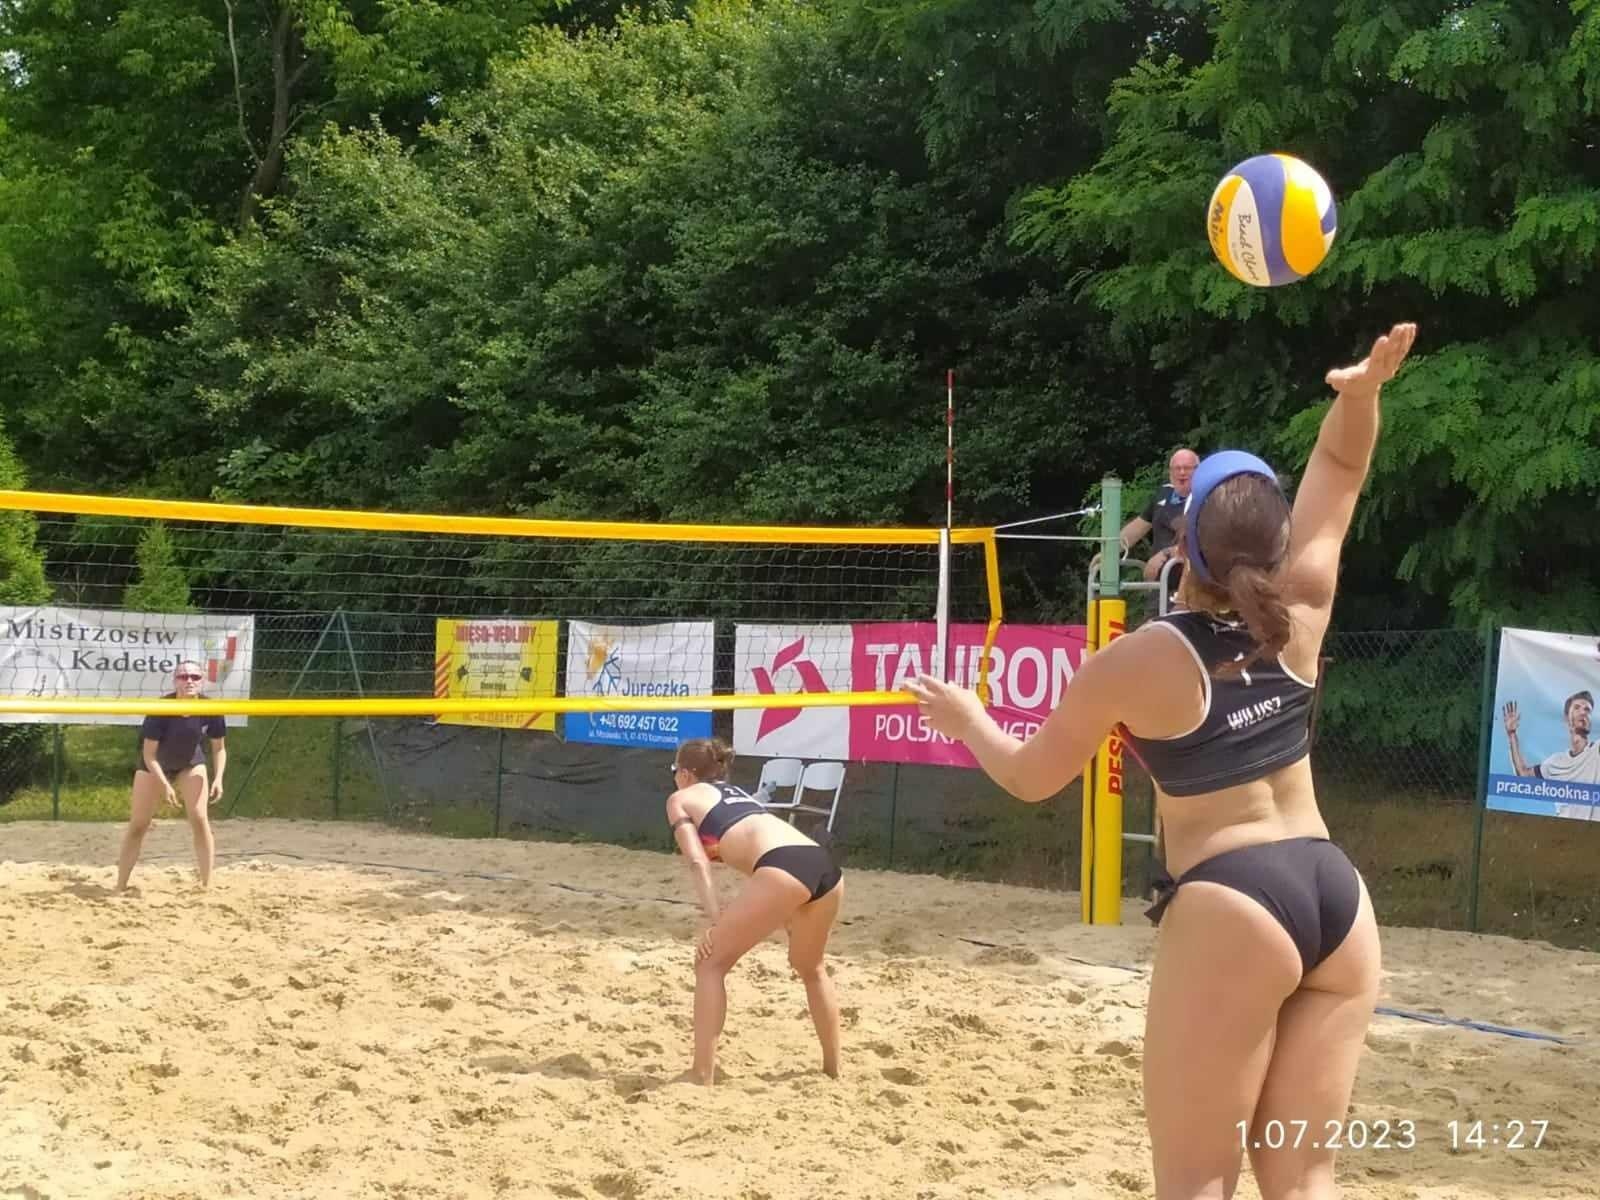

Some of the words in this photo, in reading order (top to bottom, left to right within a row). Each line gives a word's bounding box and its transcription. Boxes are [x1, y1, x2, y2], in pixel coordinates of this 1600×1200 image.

[5, 618, 179, 646] Mistrzostw
[622, 677, 690, 697] Jureczka
[617, 714, 636, 730] 692
[637, 715, 657, 731] 457
[658, 716, 679, 733] 622
[874, 713, 960, 745] POLSK
